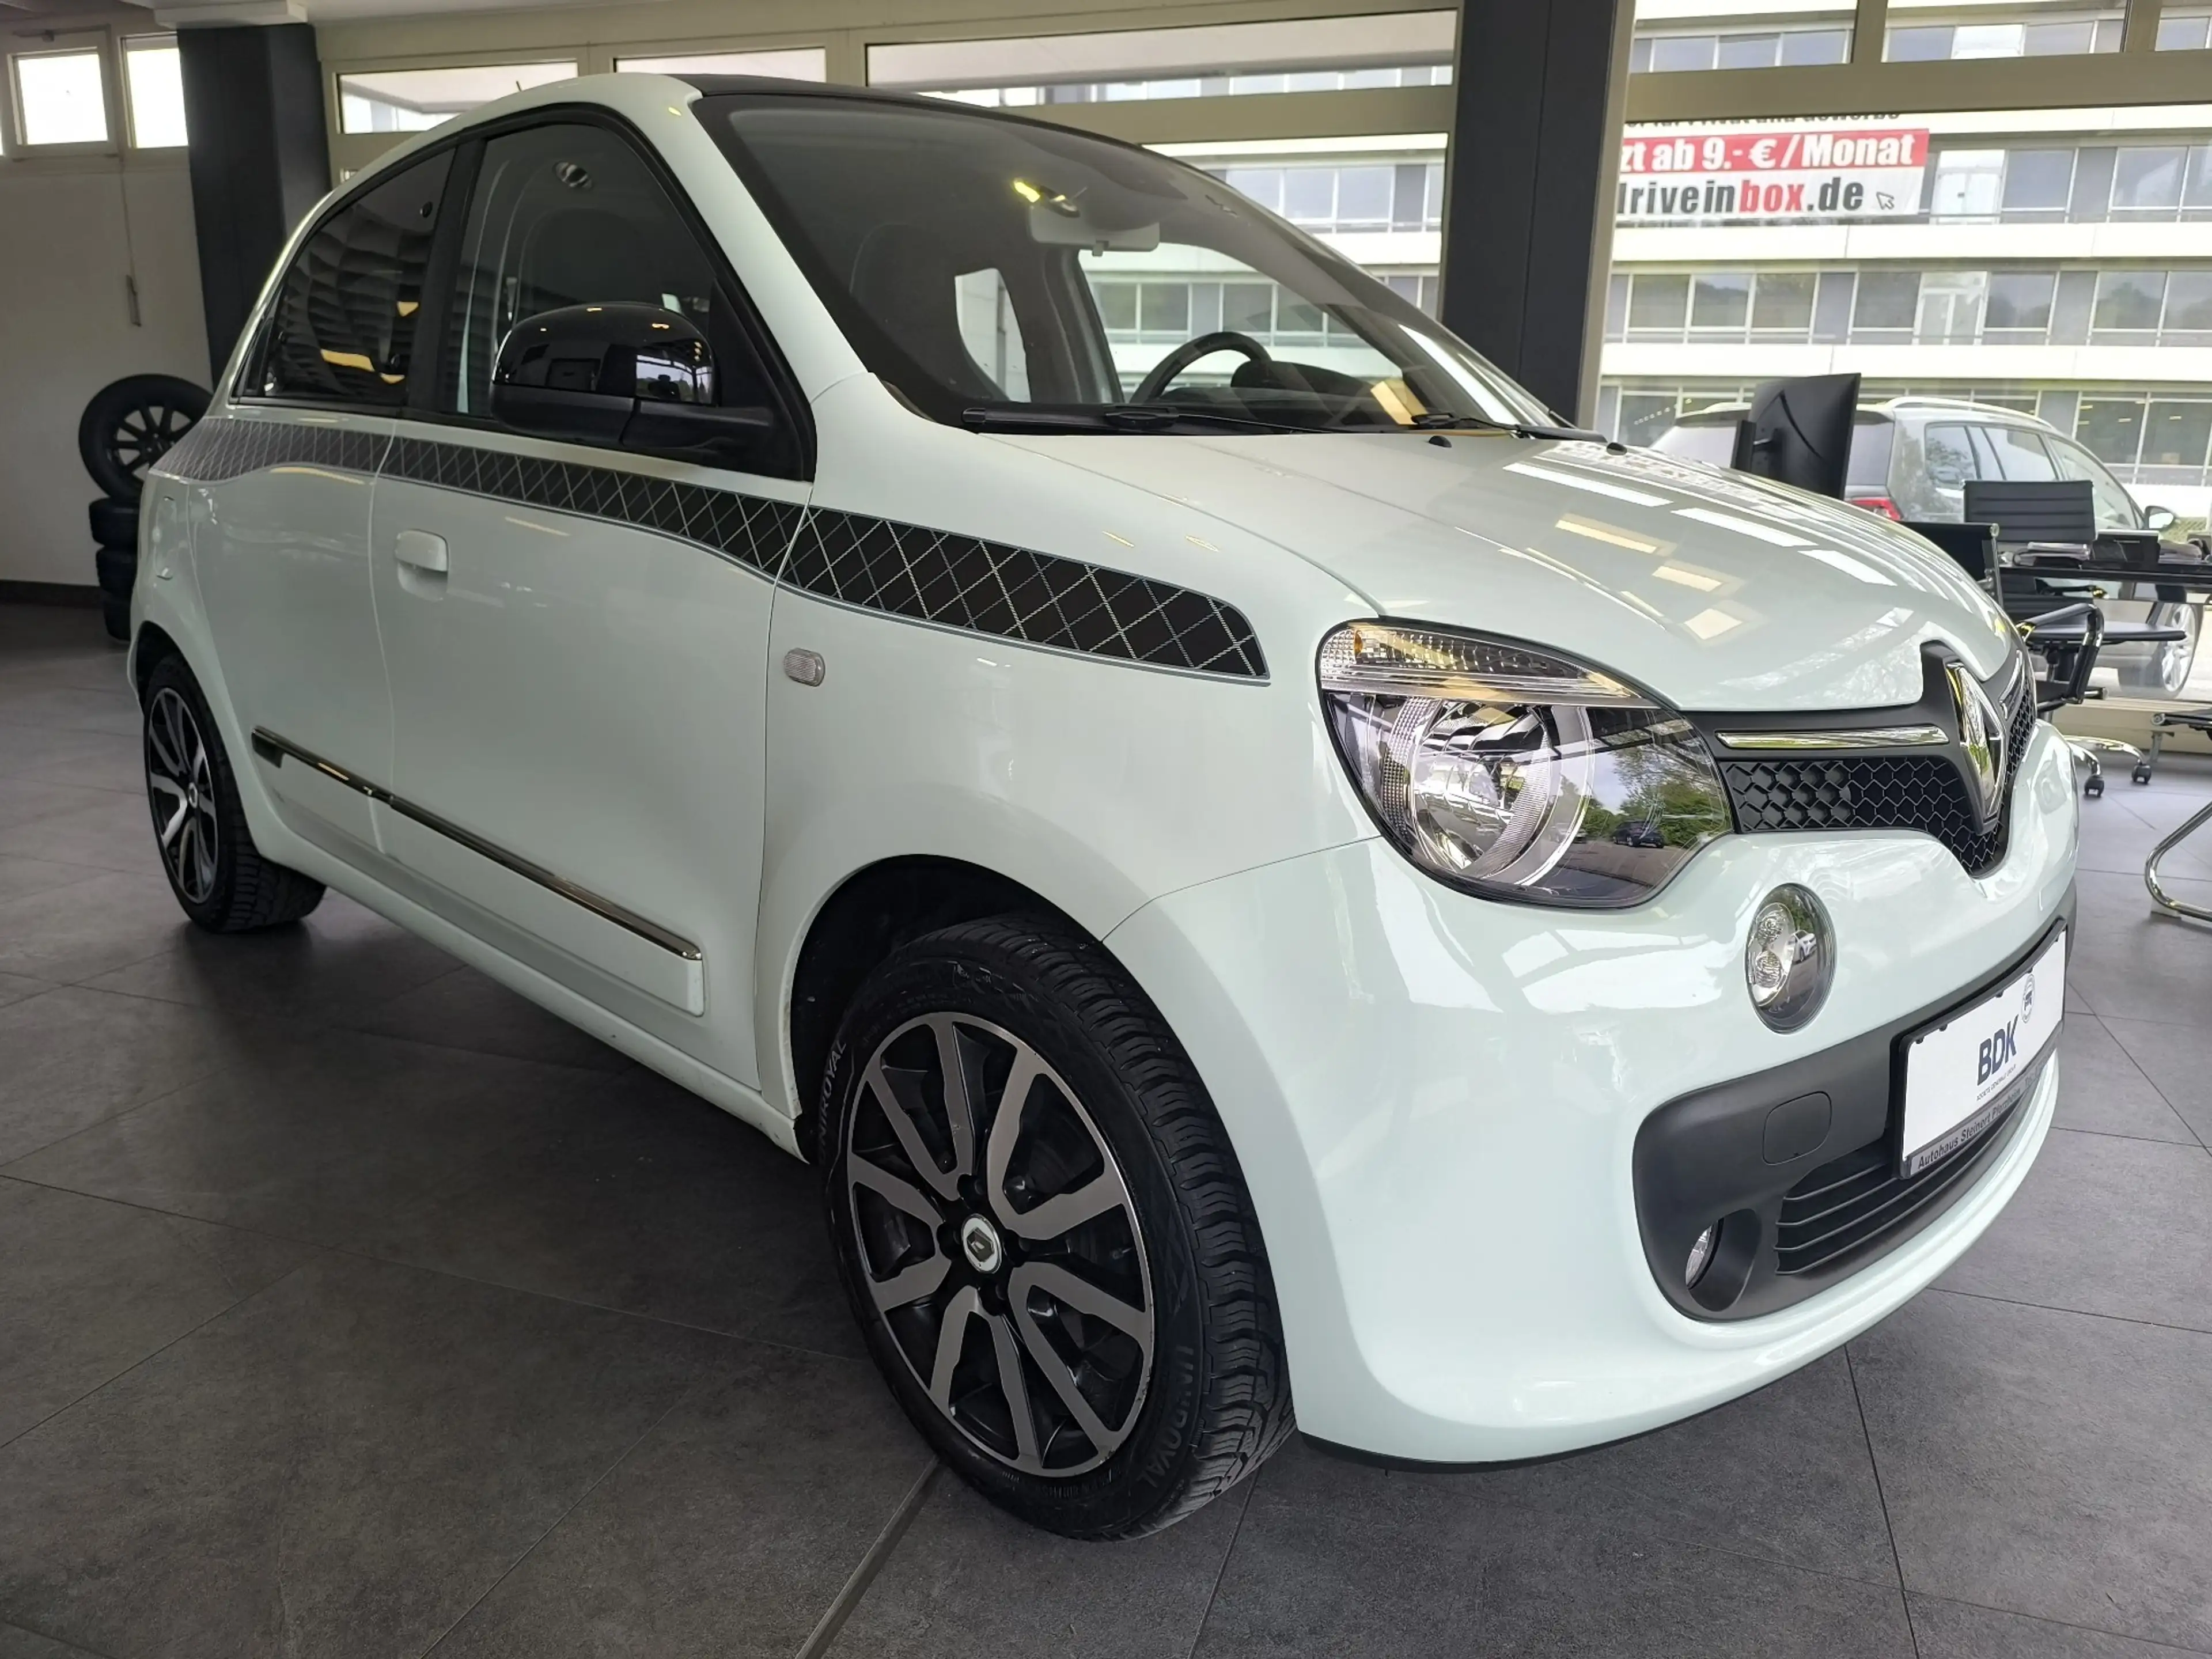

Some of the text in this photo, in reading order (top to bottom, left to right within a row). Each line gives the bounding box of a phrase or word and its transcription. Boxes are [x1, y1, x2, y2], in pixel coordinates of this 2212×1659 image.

[1651, 138, 1695, 172] ab
[1977, 1014, 2019, 1086] BDK
[1918, 1137, 1959, 1169] Autohaus
